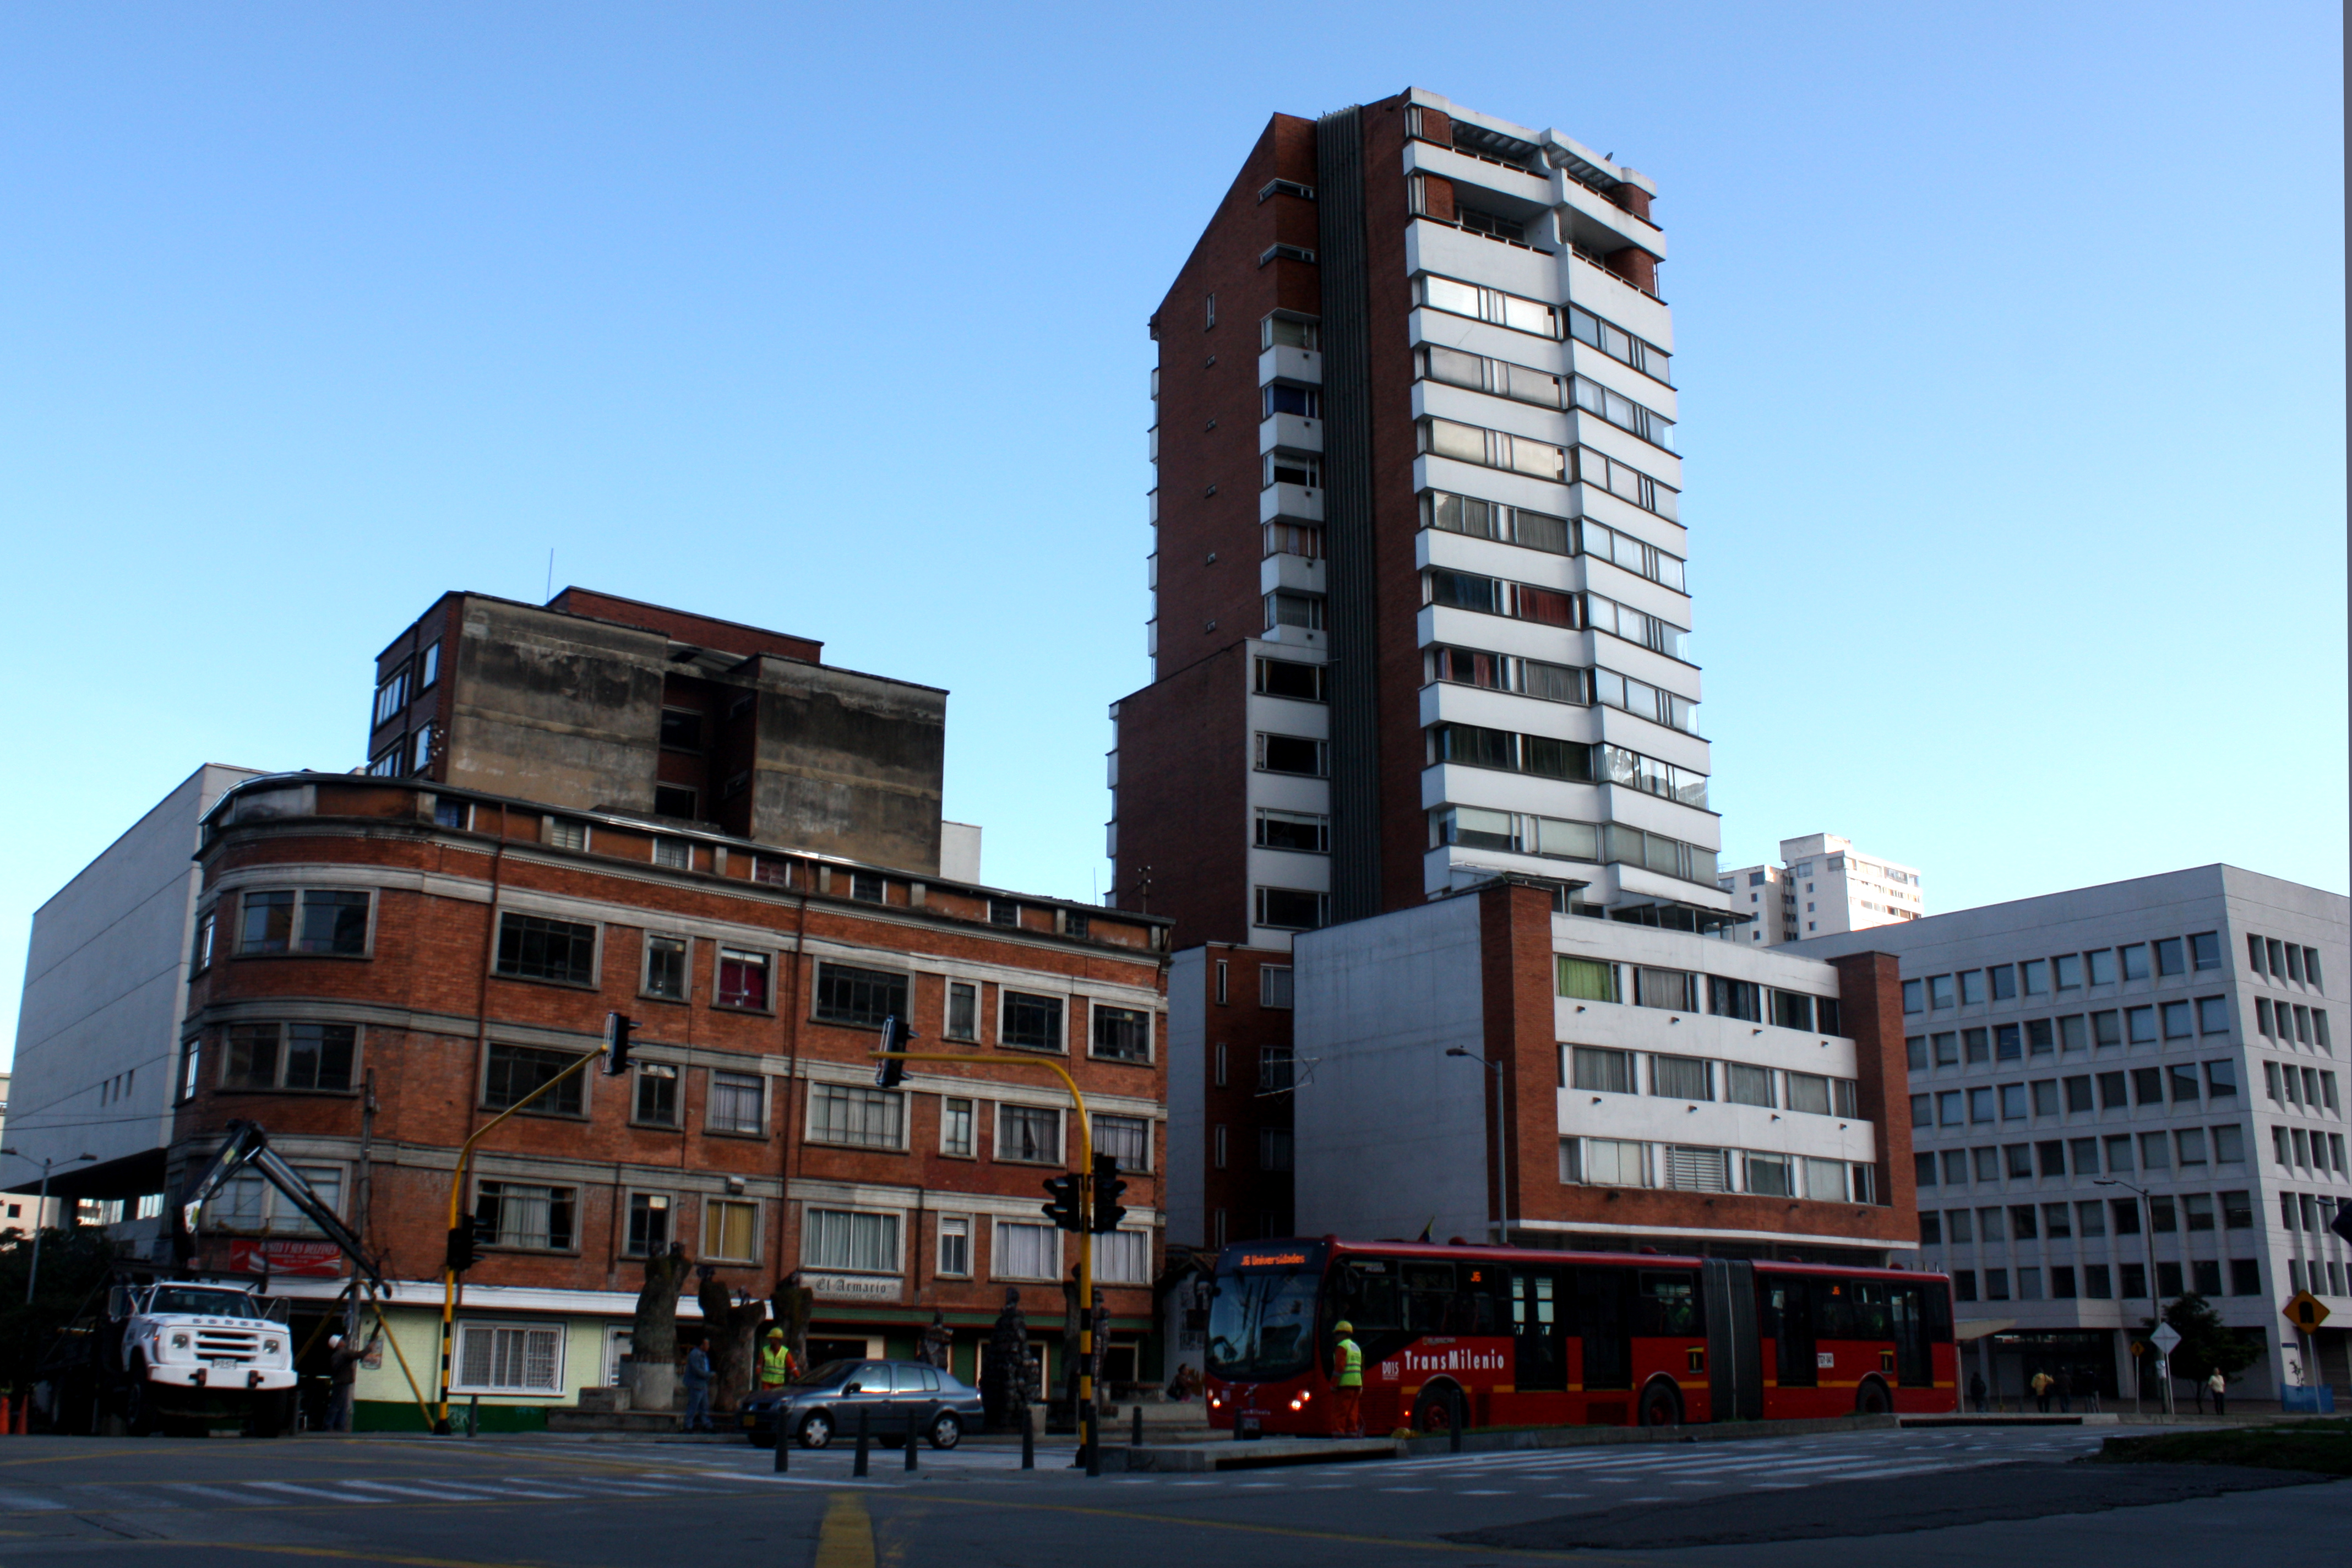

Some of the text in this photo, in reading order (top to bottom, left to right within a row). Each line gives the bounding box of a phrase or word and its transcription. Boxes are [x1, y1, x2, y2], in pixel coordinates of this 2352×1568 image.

[1251, 1253, 1305, 1265] Universidades
[1470, 1271, 1481, 1282] J6
[816, 1277, 886, 1293] El Armario
[1404, 1348, 1505, 1370] TransMilenio
[1381, 1361, 1400, 1375] D015
